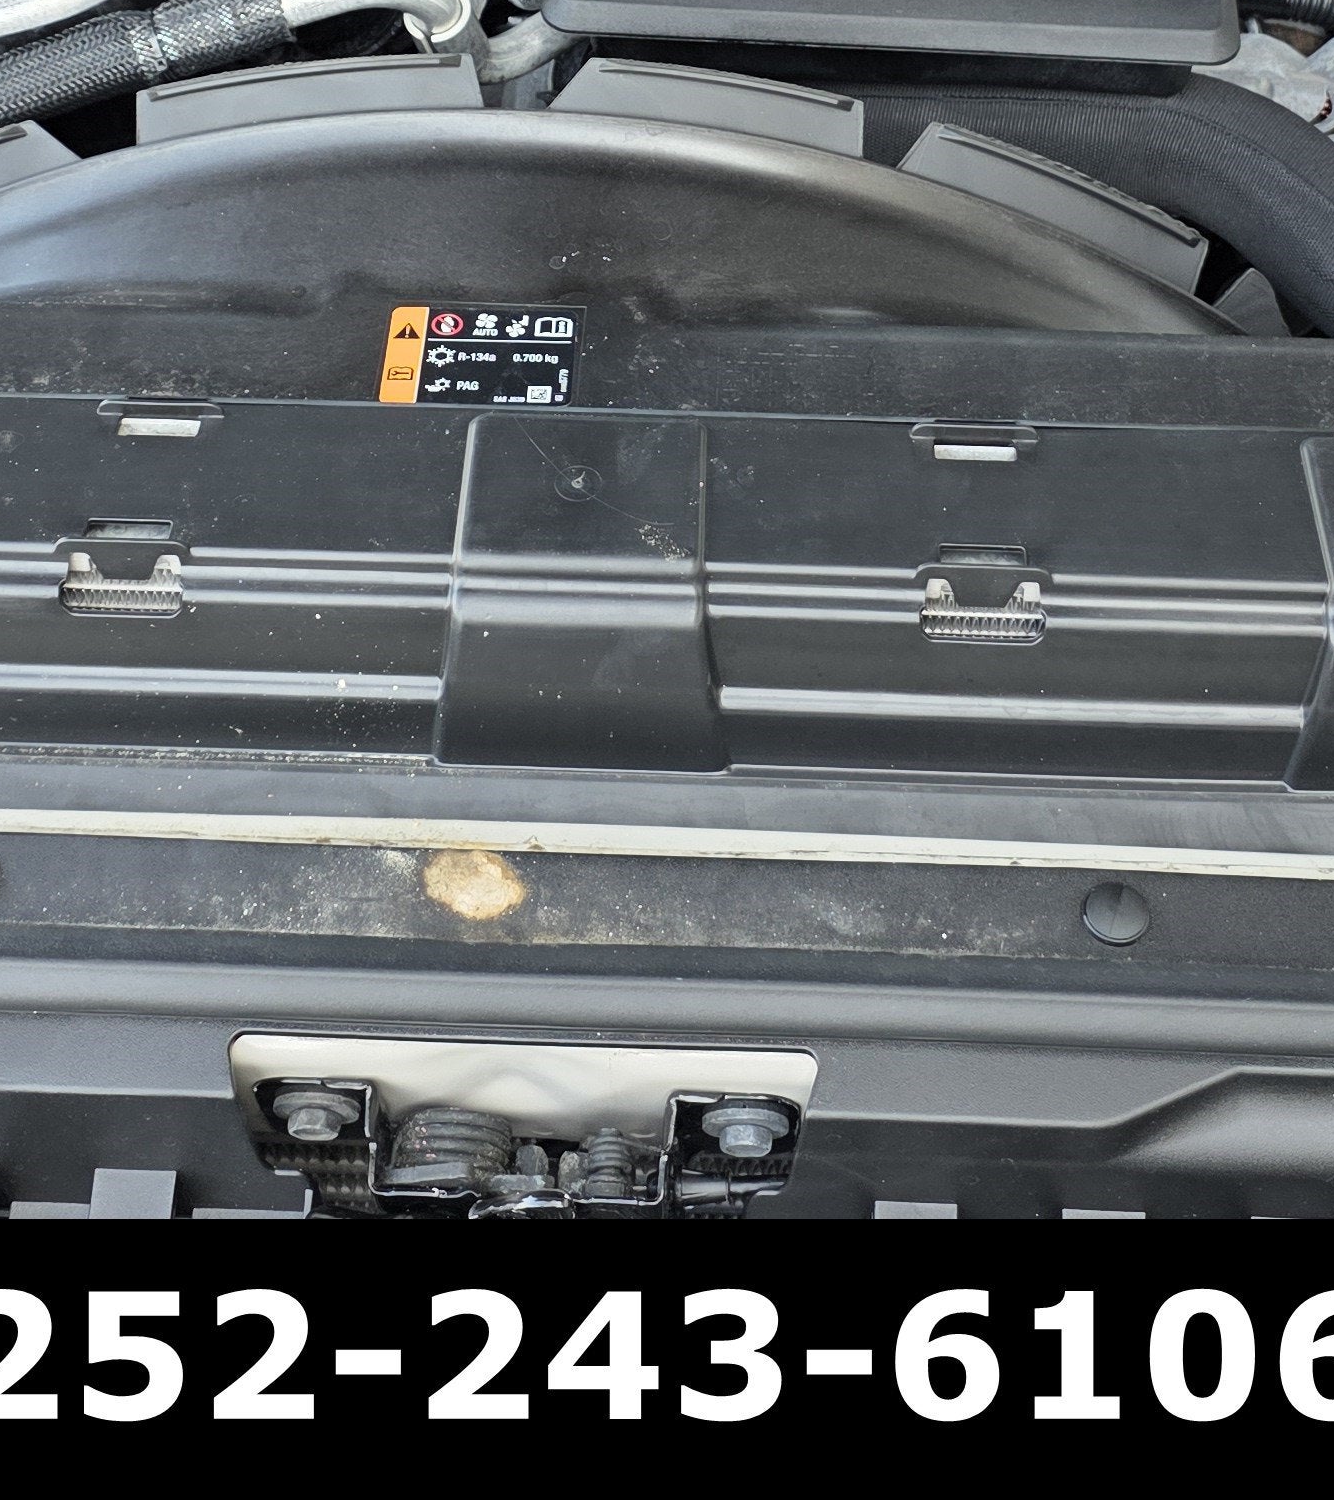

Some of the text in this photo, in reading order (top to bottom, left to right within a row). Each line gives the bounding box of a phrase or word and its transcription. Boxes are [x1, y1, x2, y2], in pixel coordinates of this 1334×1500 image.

[472, 328, 498, 337] AUTO
[457, 352, 559, 365] R-134a 0.700 kg
[456, 380, 480, 391] PAG
